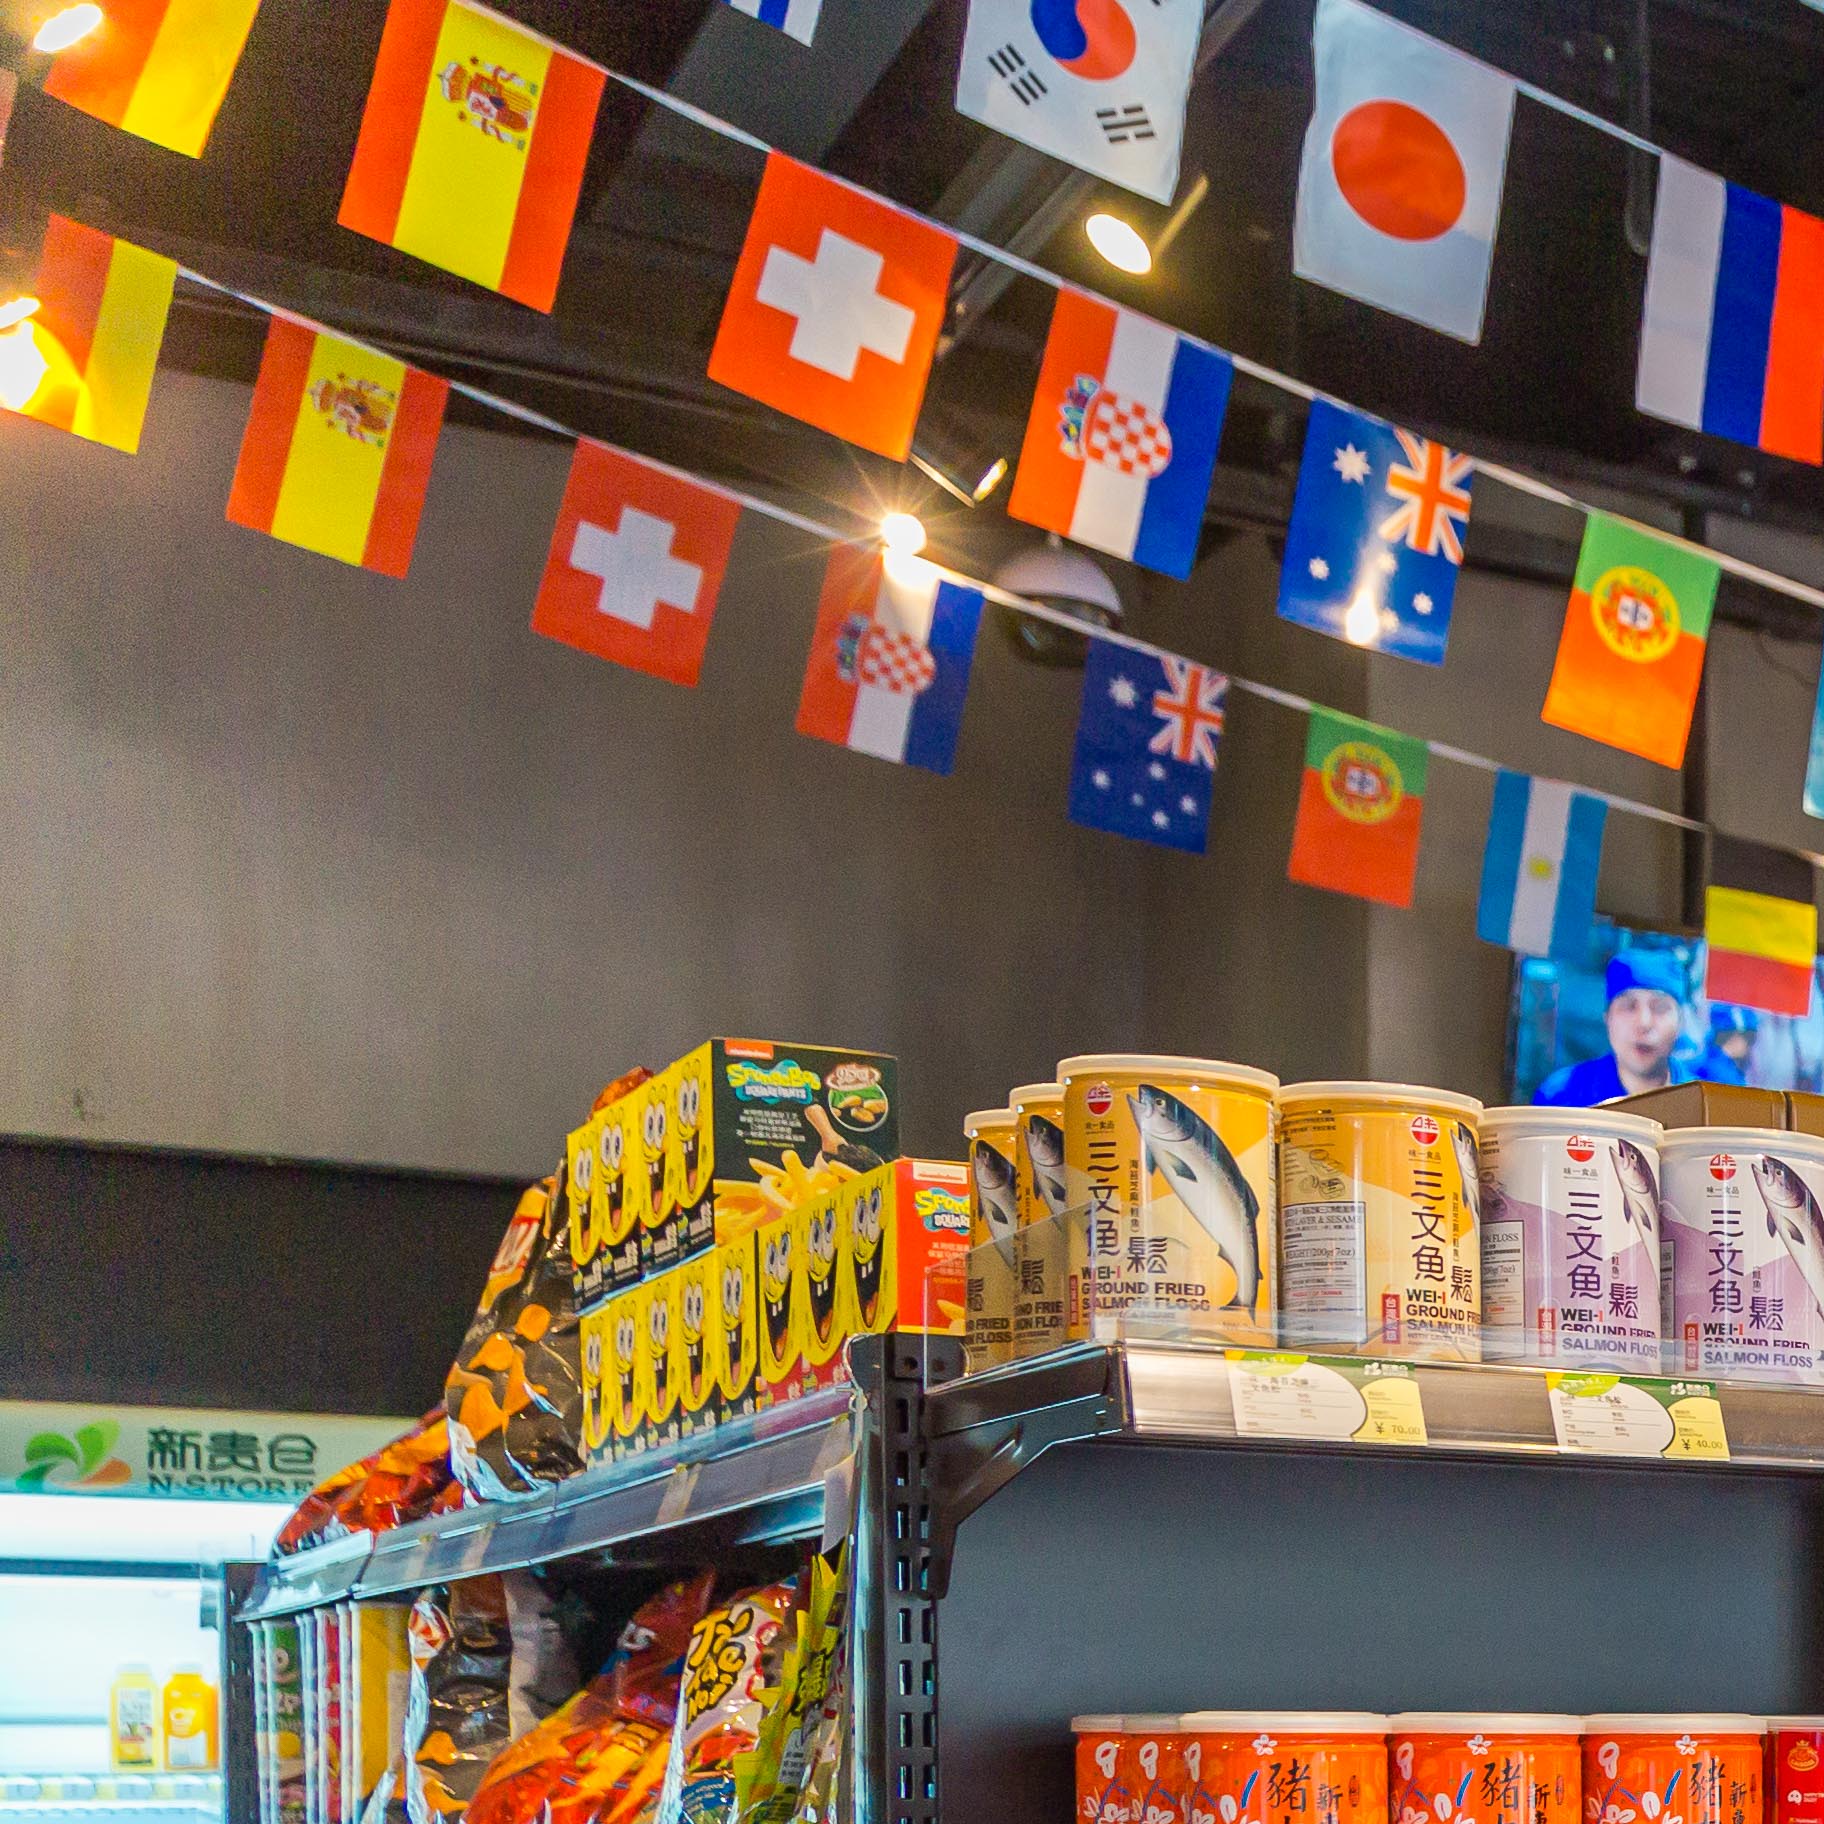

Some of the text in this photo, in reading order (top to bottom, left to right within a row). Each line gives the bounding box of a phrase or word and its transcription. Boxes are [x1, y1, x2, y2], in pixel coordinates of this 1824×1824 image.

[1411, 1169, 1446, 1282] 三文魚
[1566, 1191, 1603, 1300] 三文魚
[1708, 1209, 1744, 1315] 三文魚
[1082, 1282, 1206, 1296] GROUND FRIED
[1406, 1289, 1446, 1304] WEI-I
[1609, 1283, 1638, 1319] 鬆
[1406, 1305, 1465, 1319] GROUND
[1561, 1308, 1604, 1323] WEI-I
[1749, 1297, 1783, 1331] 鬆
[1703, 1322, 1744, 1336] WEI-I
[1562, 1337, 1627, 1354] SALMON
[1704, 1351, 1813, 1368] SALMON FLOSS
[148, 1426, 318, 1475] 新贵仓
